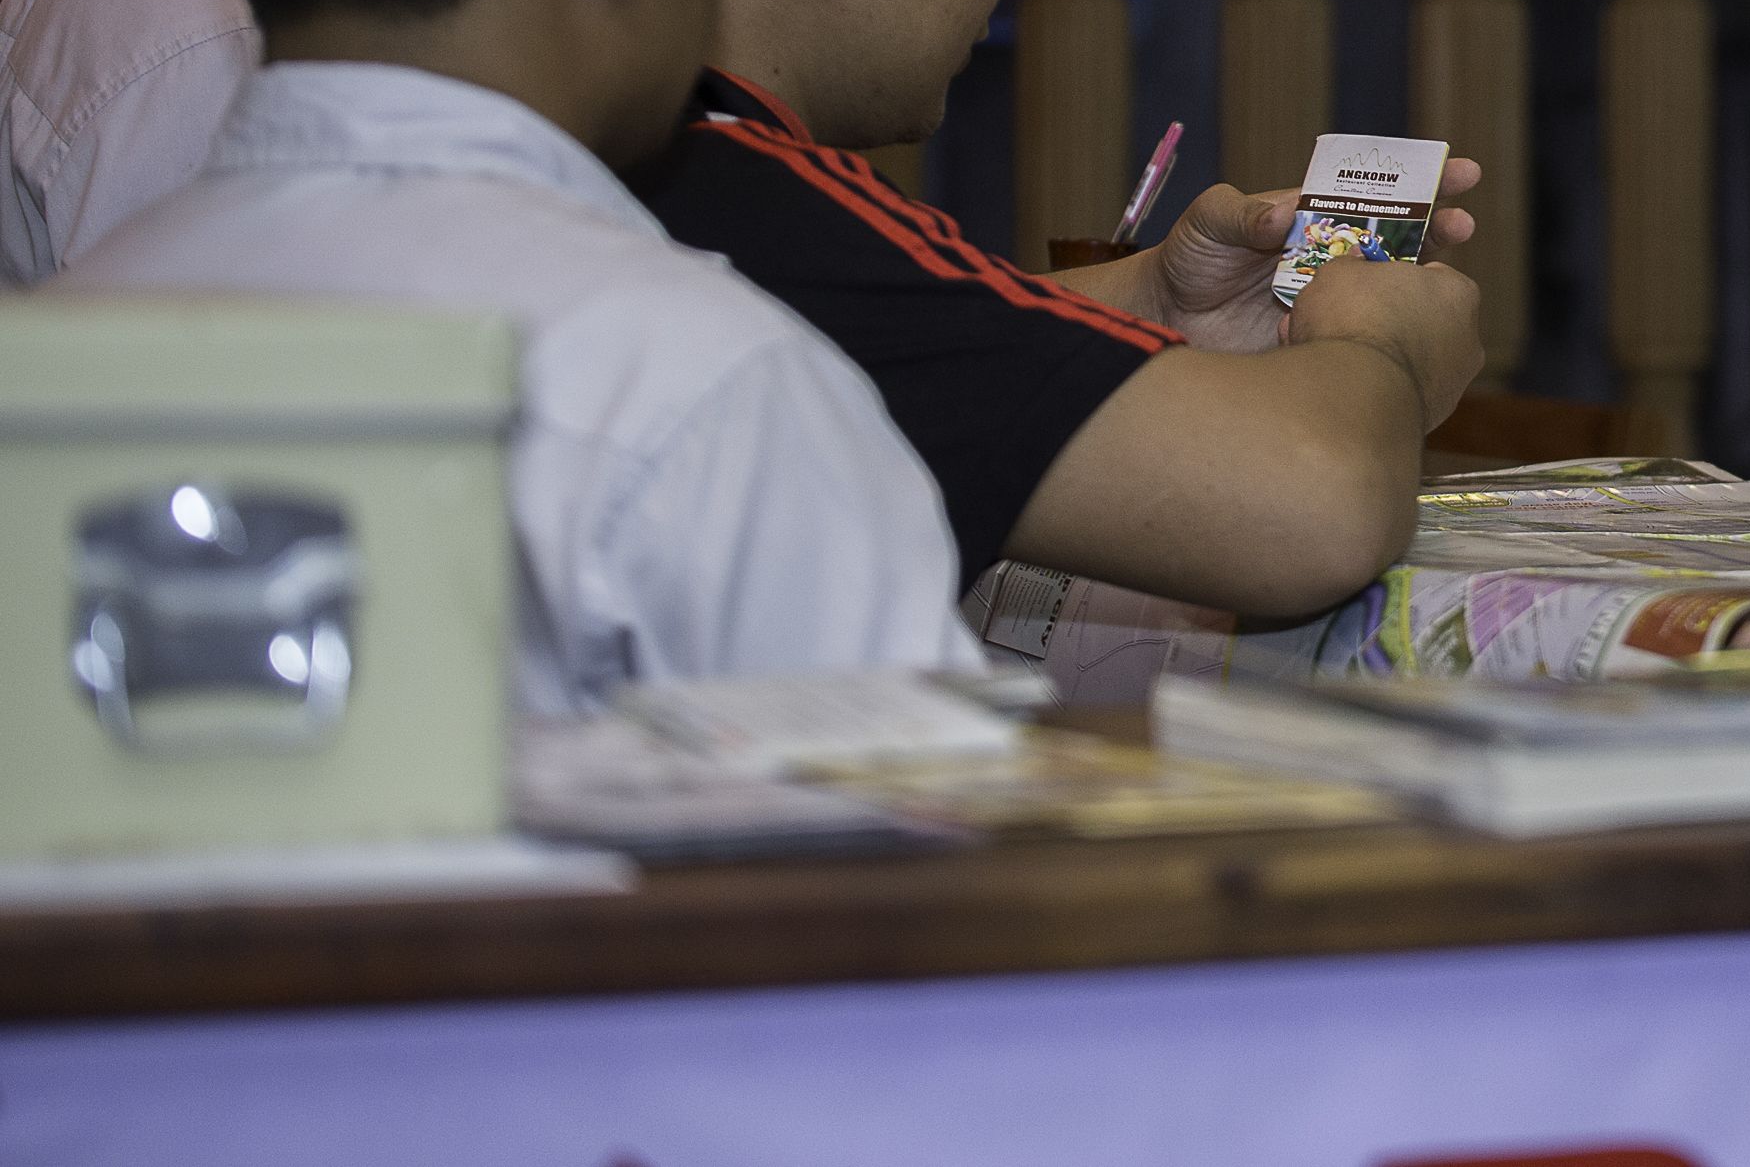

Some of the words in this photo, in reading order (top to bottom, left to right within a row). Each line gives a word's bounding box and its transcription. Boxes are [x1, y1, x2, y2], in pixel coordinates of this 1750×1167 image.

[1337, 169, 1399, 183] ANGKORW
[1310, 198, 1345, 210] Flavors
[1346, 201, 1357, 211] to
[1357, 203, 1411, 214] Remember
